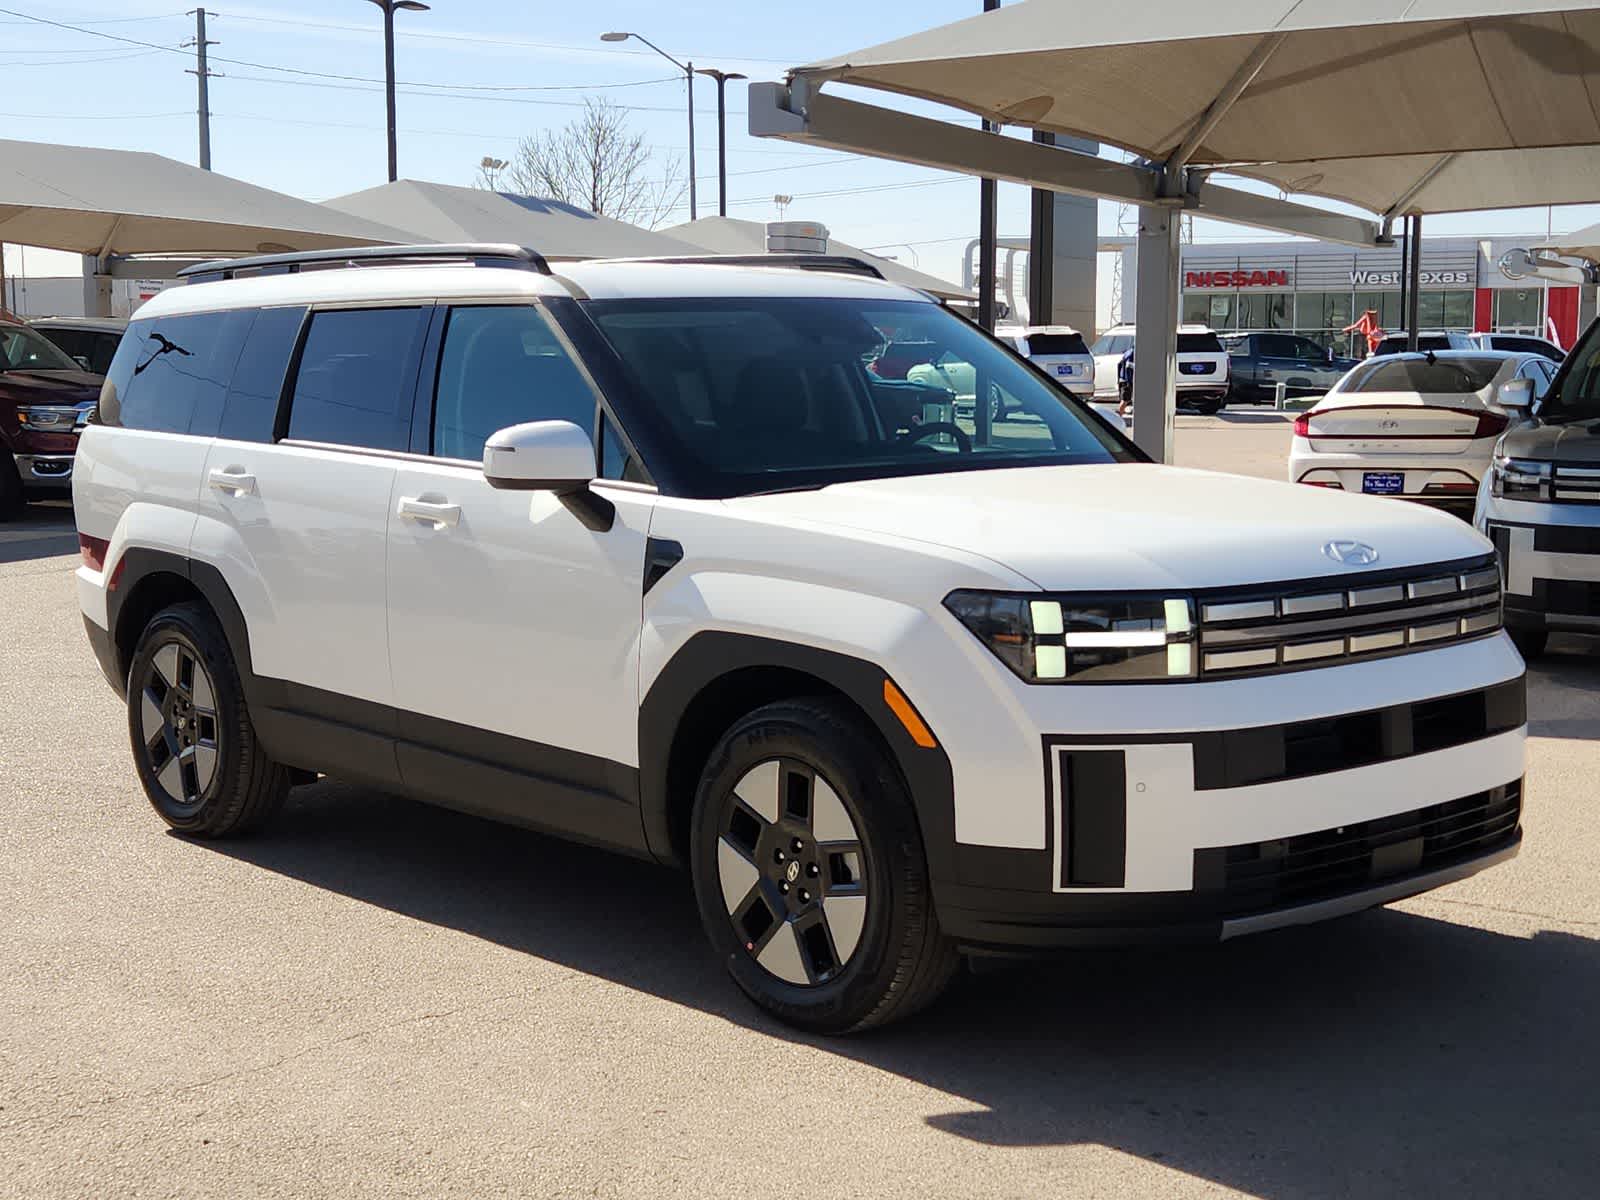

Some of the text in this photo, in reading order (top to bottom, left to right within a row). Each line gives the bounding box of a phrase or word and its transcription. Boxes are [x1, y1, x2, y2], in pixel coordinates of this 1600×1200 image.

[1186, 270, 1287, 287] NISSAN
[1349, 270, 1468, 284] West exas
